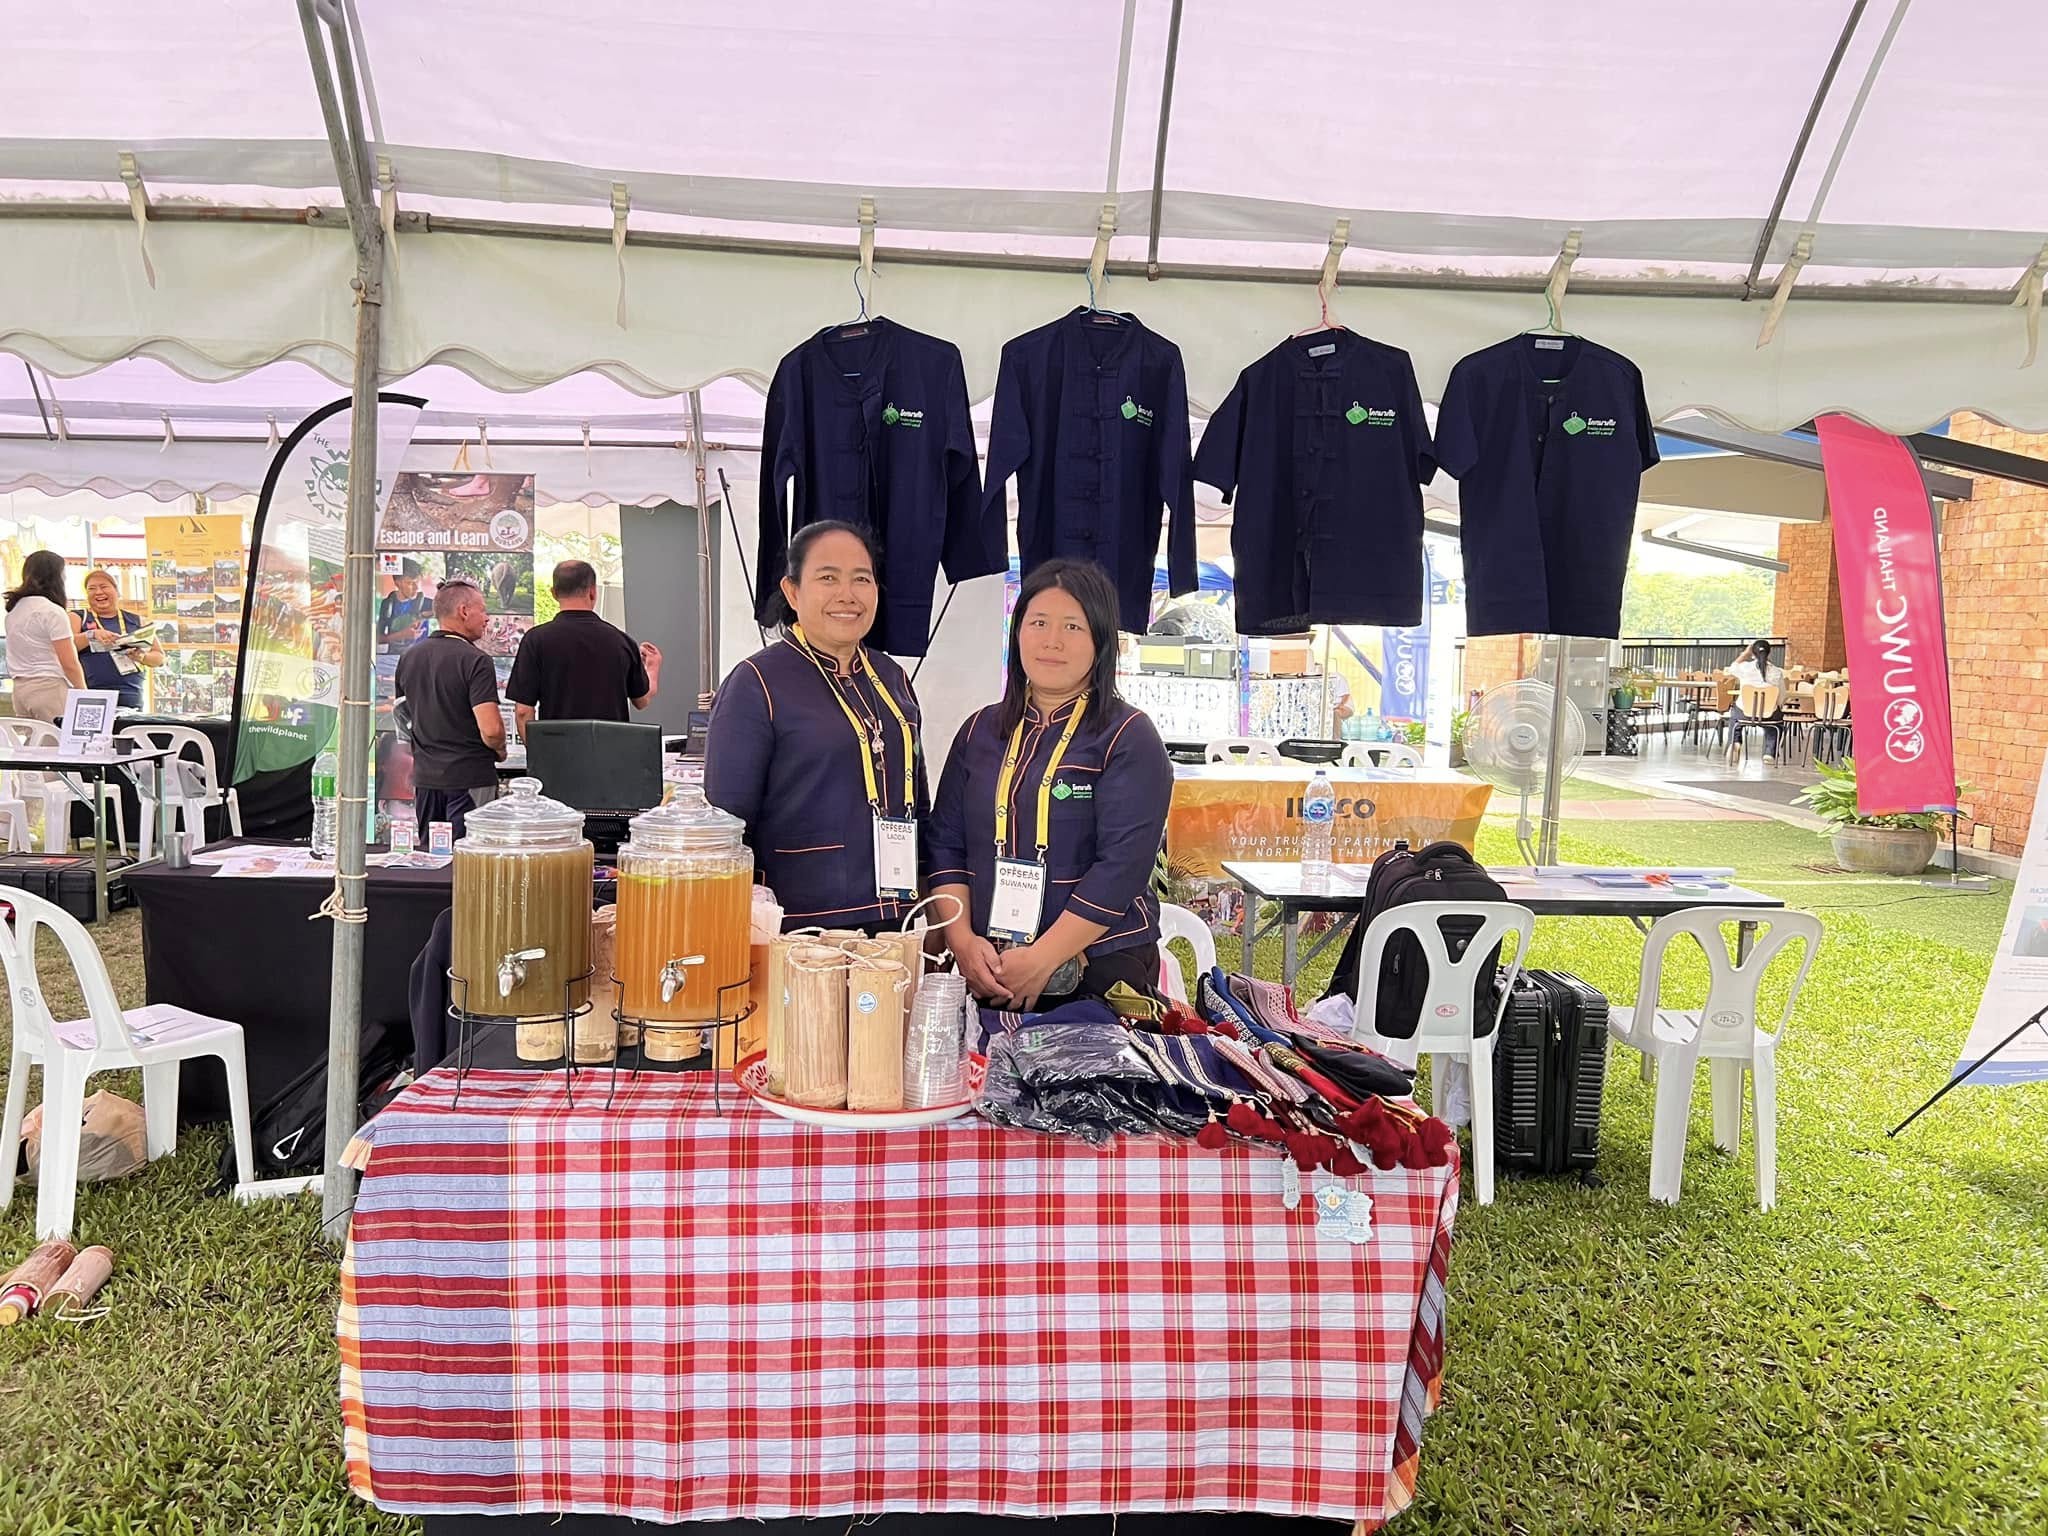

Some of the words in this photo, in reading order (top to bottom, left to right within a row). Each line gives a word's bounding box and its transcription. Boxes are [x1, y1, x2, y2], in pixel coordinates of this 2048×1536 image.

[313, 432, 331, 448] THE
[380, 529, 425, 548] Escape
[427, 529, 451, 546] and
[454, 528, 489, 546] Learn
[248, 725, 308, 741] thewildplanet
[880, 823, 913, 834] OFFSEAS
[1231, 835, 1267, 846] YOUR
[1417, 838, 1432, 848] IN
[999, 867, 1041, 881] OFFSEAS
[999, 878, 1039, 890] SUWANNA
